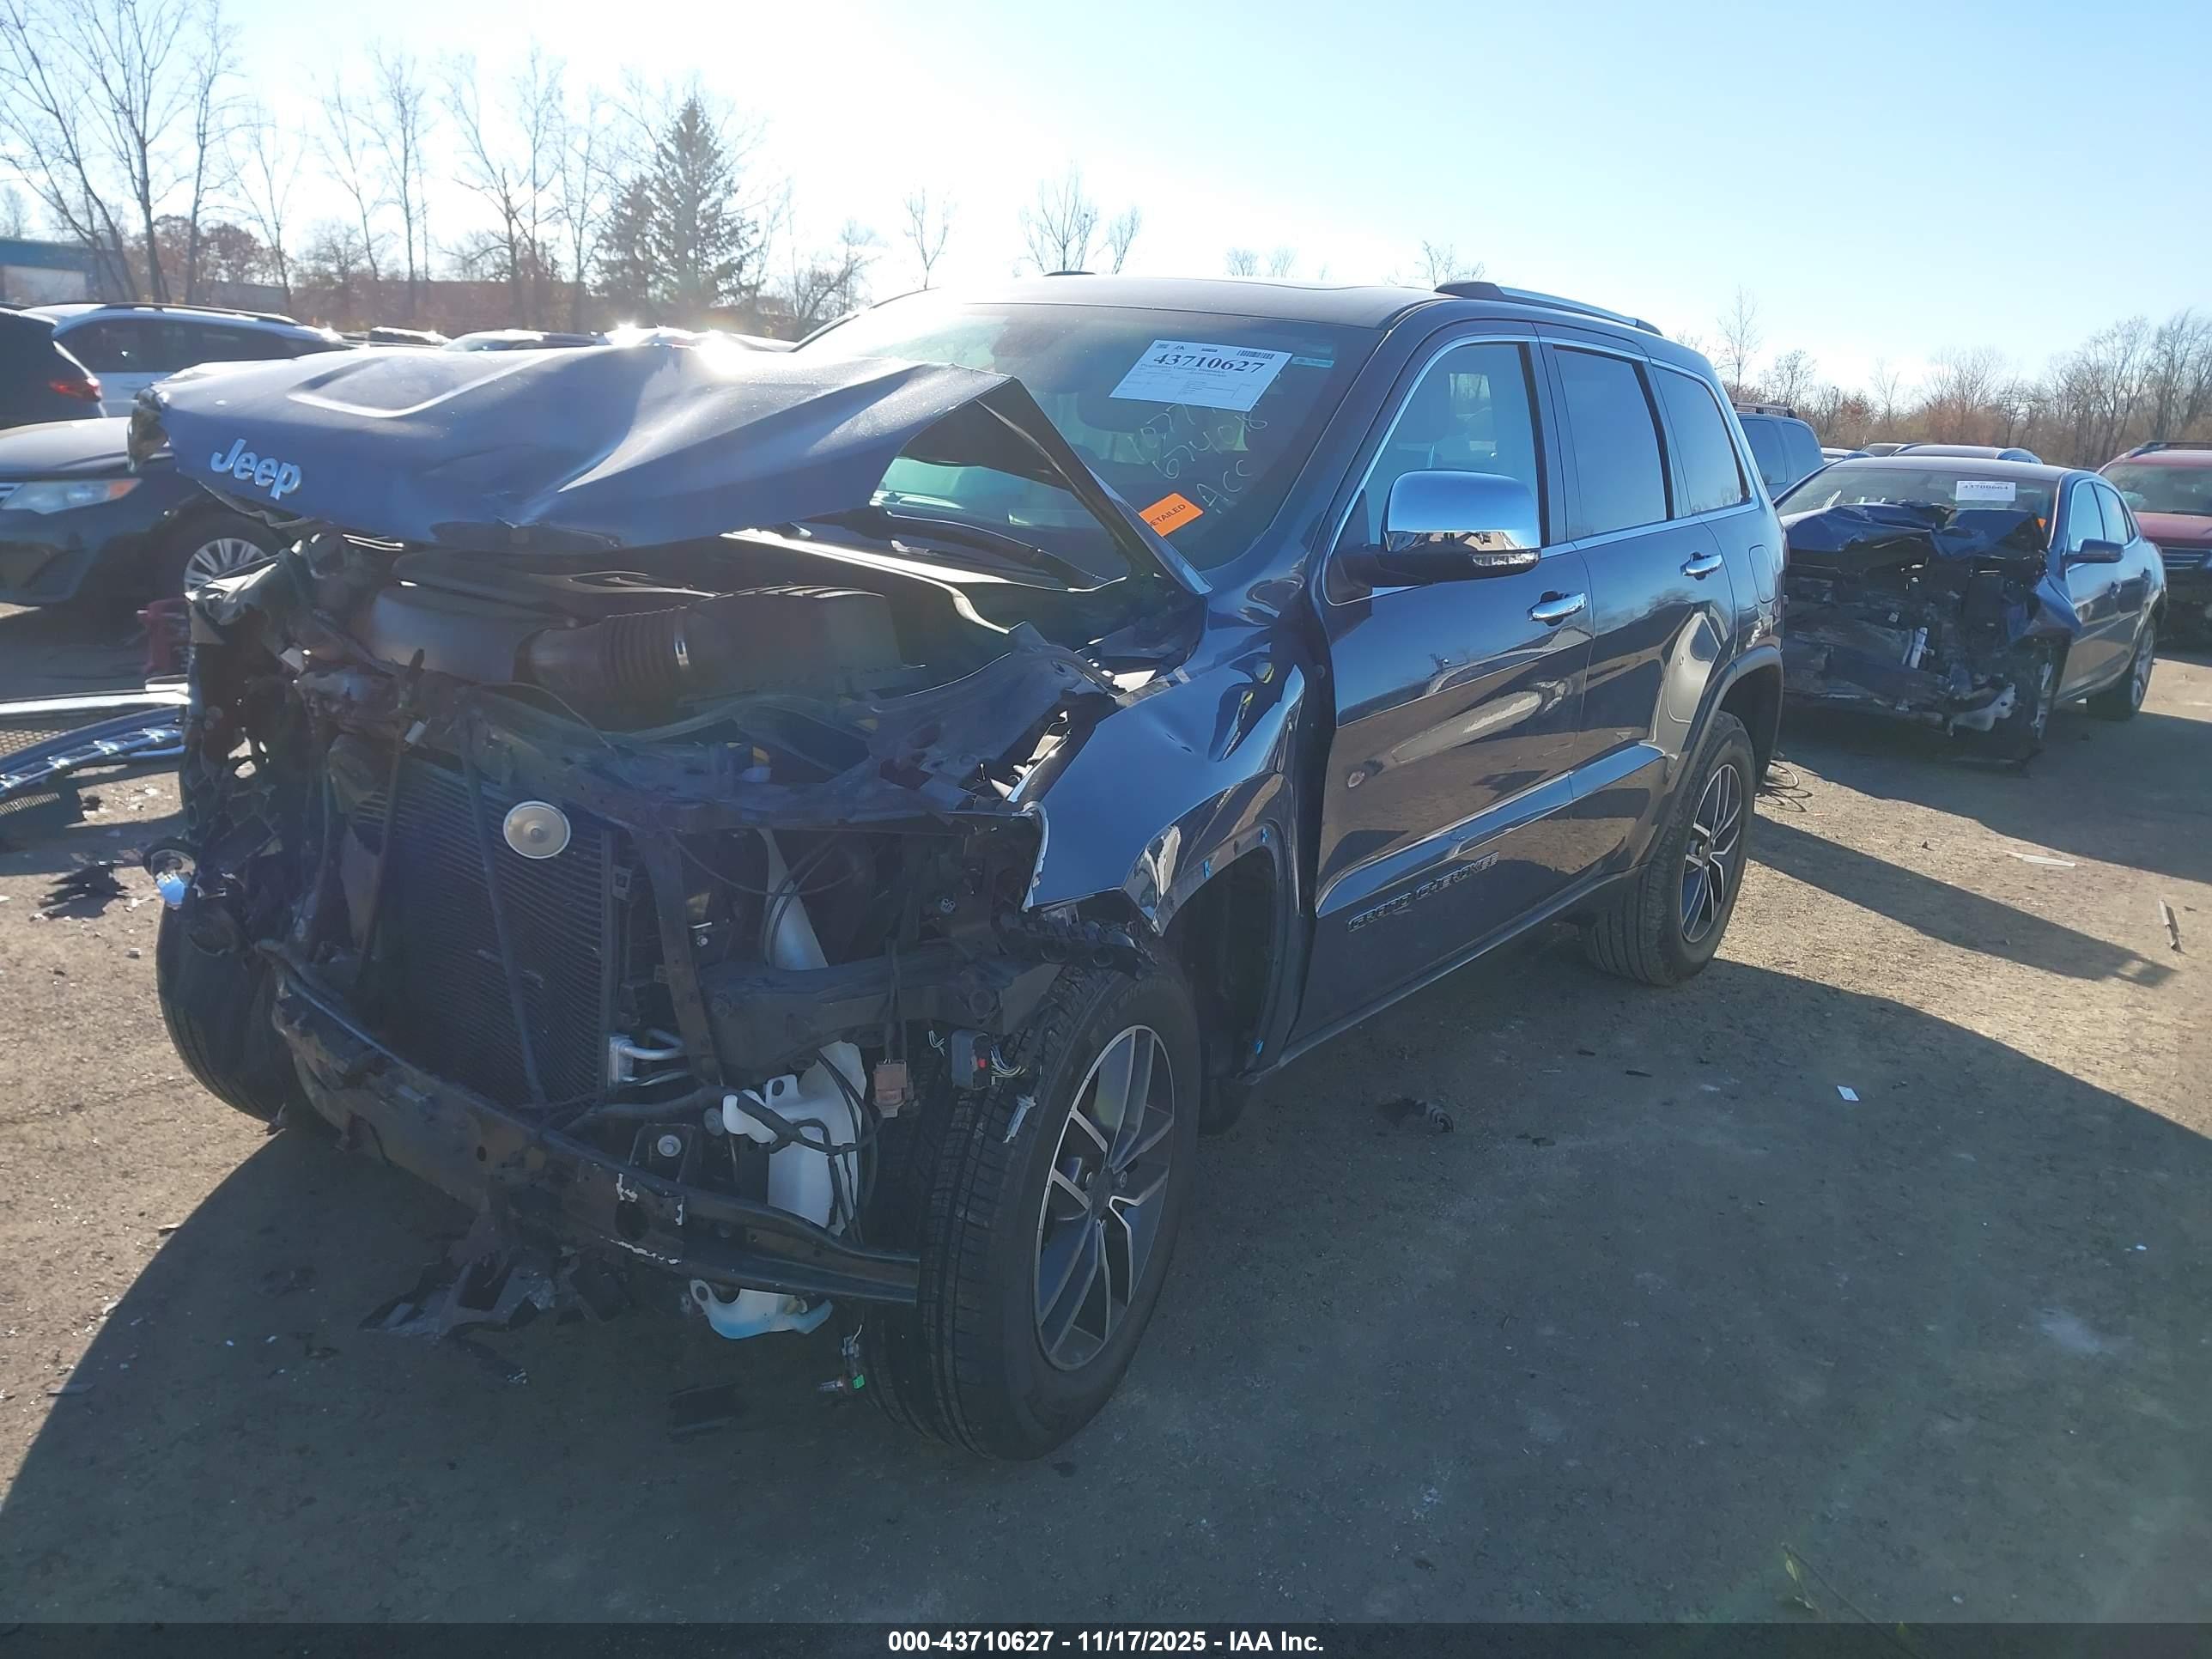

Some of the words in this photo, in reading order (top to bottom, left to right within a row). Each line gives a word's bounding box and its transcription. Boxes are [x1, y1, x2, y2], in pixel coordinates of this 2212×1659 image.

[1153, 353, 1266, 374] 43710627
[210, 438, 302, 501] Jeep
[1150, 504, 1186, 526] ETAILED
